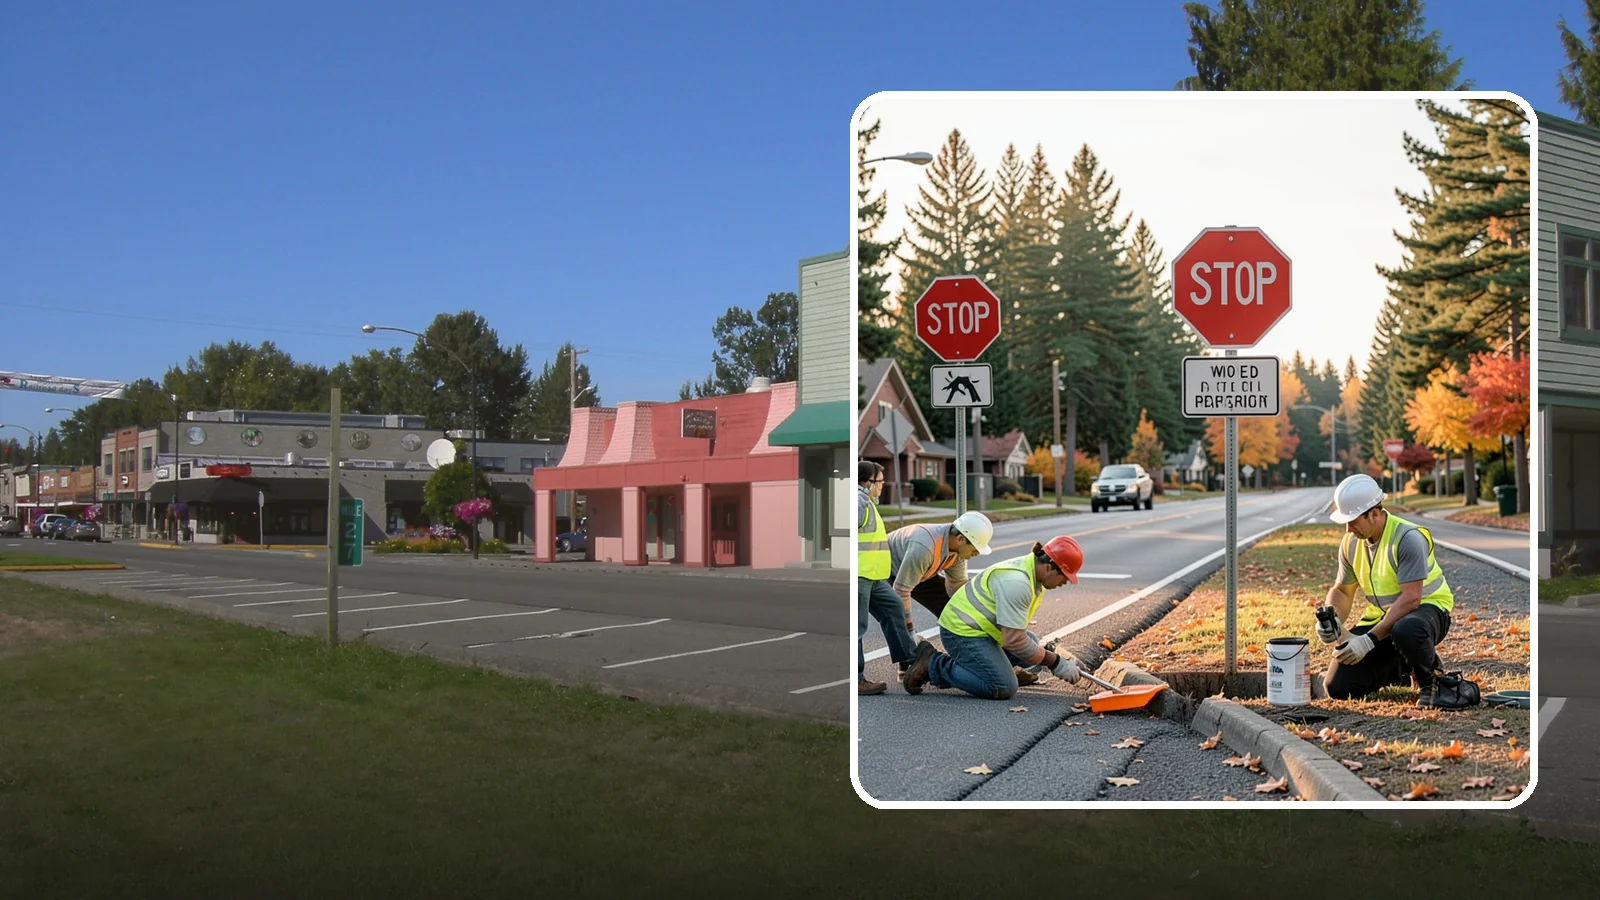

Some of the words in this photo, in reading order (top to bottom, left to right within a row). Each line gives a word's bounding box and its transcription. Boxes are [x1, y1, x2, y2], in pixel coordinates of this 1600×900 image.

[1189, 260, 1277, 305] STOP
[927, 301, 990, 335] STOP
[20, 379, 57, 392] Railroad
[341, 505, 362, 517] MILE
